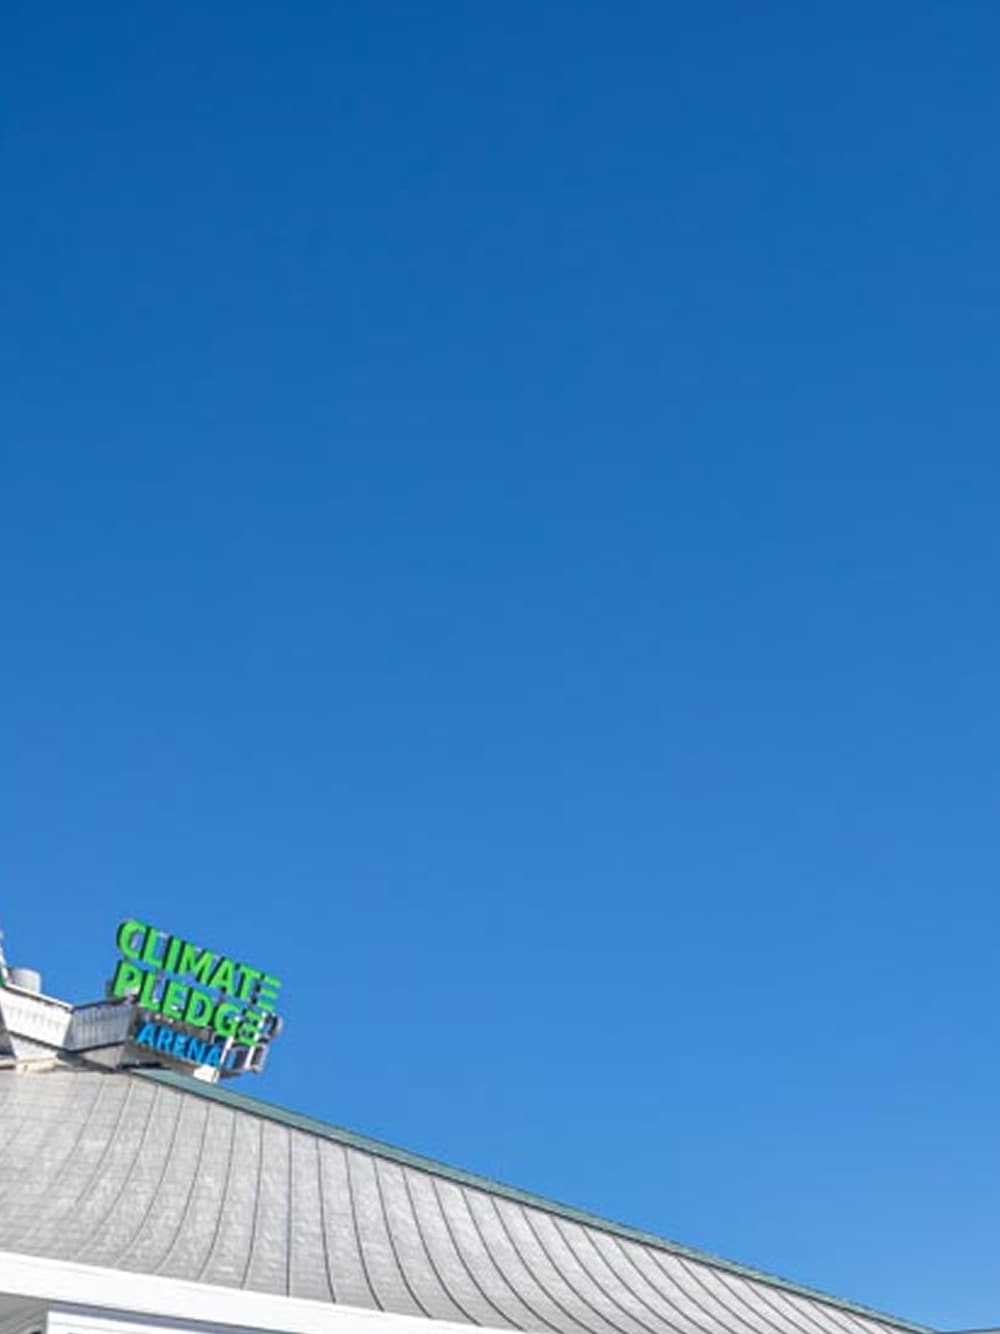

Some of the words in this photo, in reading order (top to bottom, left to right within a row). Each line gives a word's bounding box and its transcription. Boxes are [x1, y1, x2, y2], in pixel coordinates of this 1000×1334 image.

[111, 960, 261, 1047] PLEDGE
[116, 918, 282, 1011] CLIMATE
[135, 1020, 223, 1069] ARENA
